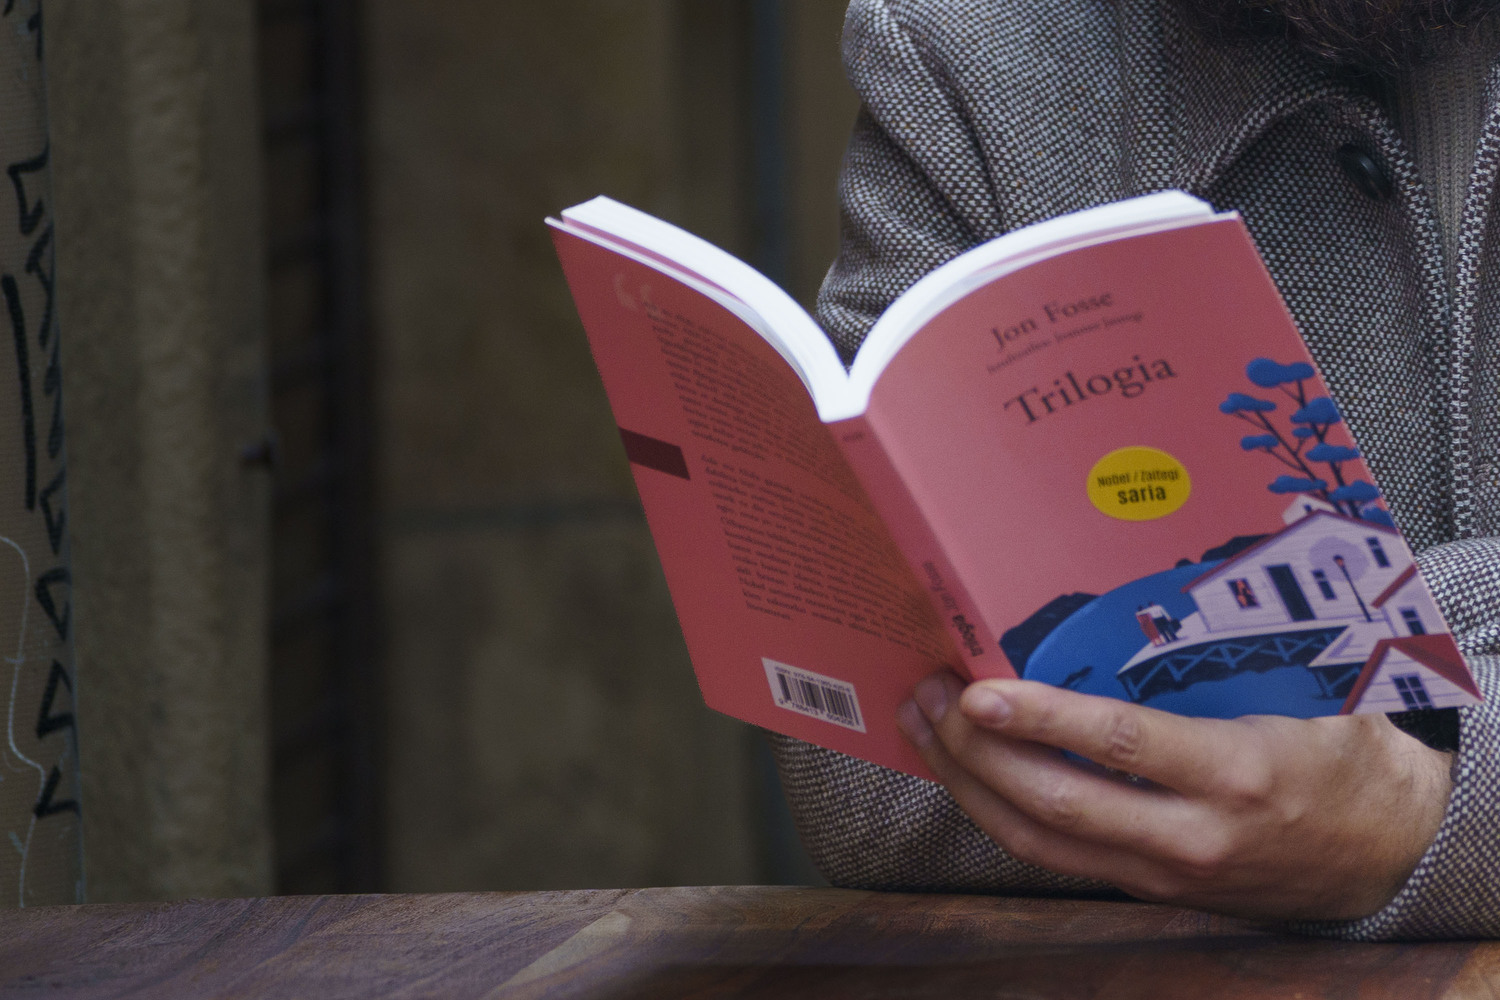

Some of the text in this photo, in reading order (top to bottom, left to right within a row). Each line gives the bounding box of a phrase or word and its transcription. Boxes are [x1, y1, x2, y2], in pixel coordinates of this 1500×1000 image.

[992, 317, 1038, 350] Jon
[1043, 293, 1113, 323] Fosse
[1002, 354, 1178, 424] Trilogia
[1097, 472, 1130, 487] Nobel
[1117, 484, 1166, 505] saria
